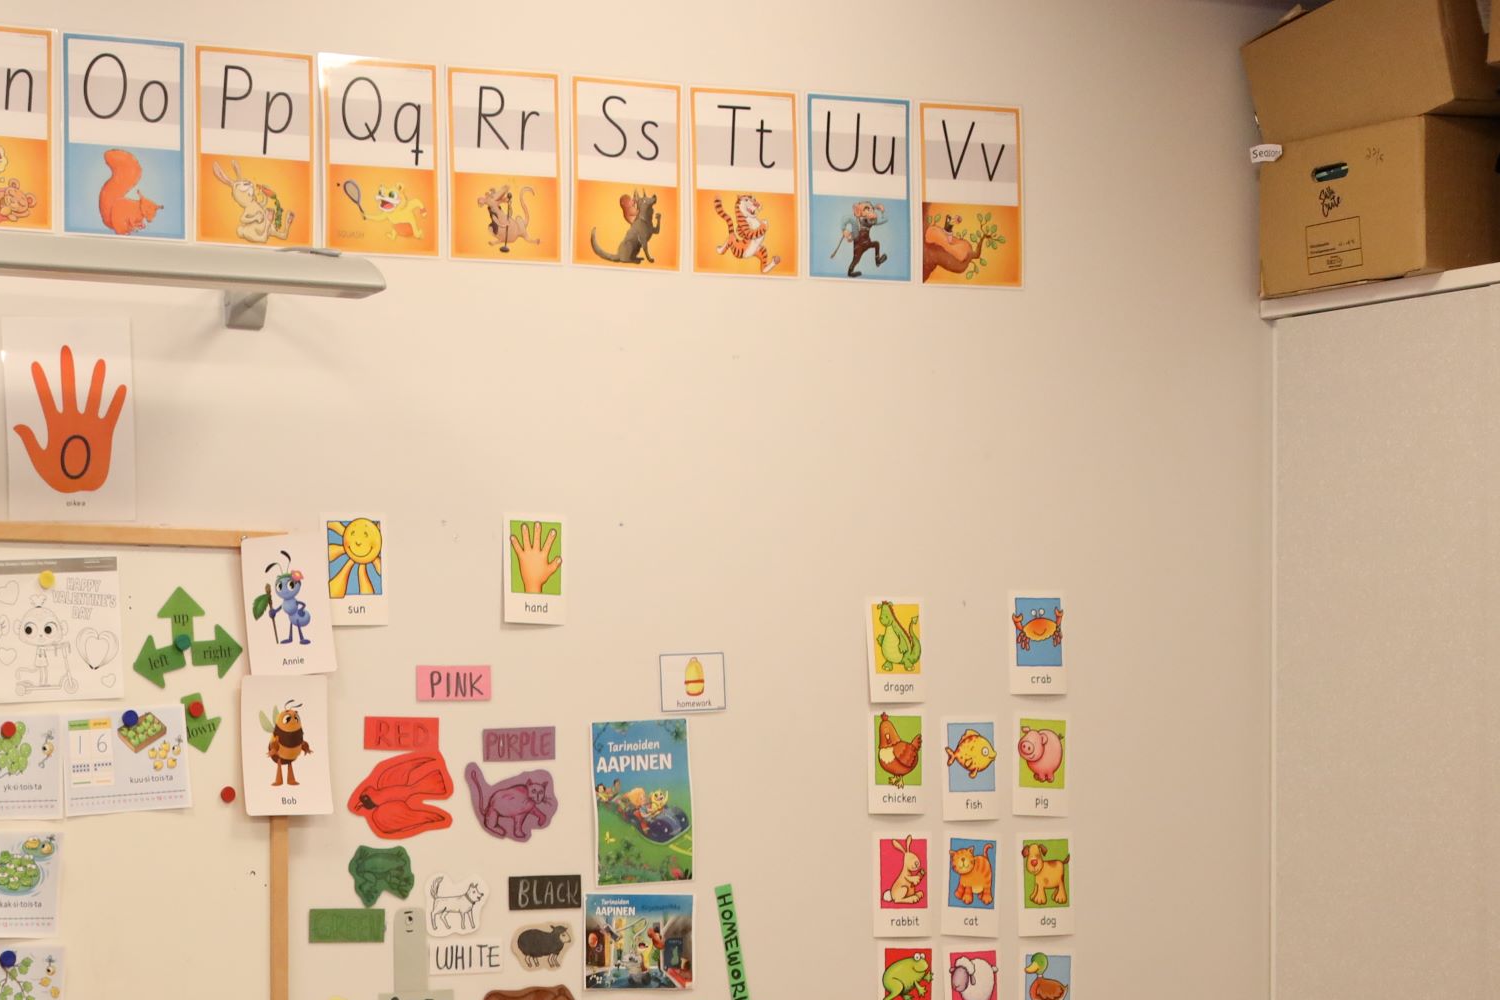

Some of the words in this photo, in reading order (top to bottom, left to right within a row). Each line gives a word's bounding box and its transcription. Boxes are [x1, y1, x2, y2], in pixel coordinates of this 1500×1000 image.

[83, 52, 169, 124] Oo
[220, 64, 293, 155] Pp
[341, 76, 424, 166] Qq
[476, 85, 541, 151] Rr
[593, 95, 661, 162] Ss
[717, 104, 776, 169] Tt
[825, 110, 897, 176] Uu
[941, 118, 1006, 182] Vv
[66, 577, 102, 592] HAPPY
[72, 606, 93, 620] DAY
[348, 605, 366, 614] sun
[525, 602, 548, 613] hand
[173, 613, 189, 626] up
[203, 646, 232, 660] right
[148, 654, 169, 671] left
[282, 656, 305, 666] Annie
[428, 670, 484, 698] PINK
[1031, 675, 1052, 684] crab
[884, 682, 914, 694] dragon
[677, 699, 712, 708] homework
[375, 720, 429, 747] RED
[485, 731, 553, 760] PURPLE
[608, 740, 660, 752] Tarinoiden
[596, 753, 672, 773] AAPINEN
[281, 796, 297, 805] Bob
[882, 793, 917, 803] chicken
[965, 799, 982, 810] fish
[1035, 797, 1049, 809] pig
[517, 878, 580, 908] BLACK
[596, 906, 636, 916] AAPINEN
[890, 917, 920, 926] rabbit
[964, 917, 979, 926] cat
[1040, 916, 1057, 928] dog
[436, 944, 500, 971] WHITE
